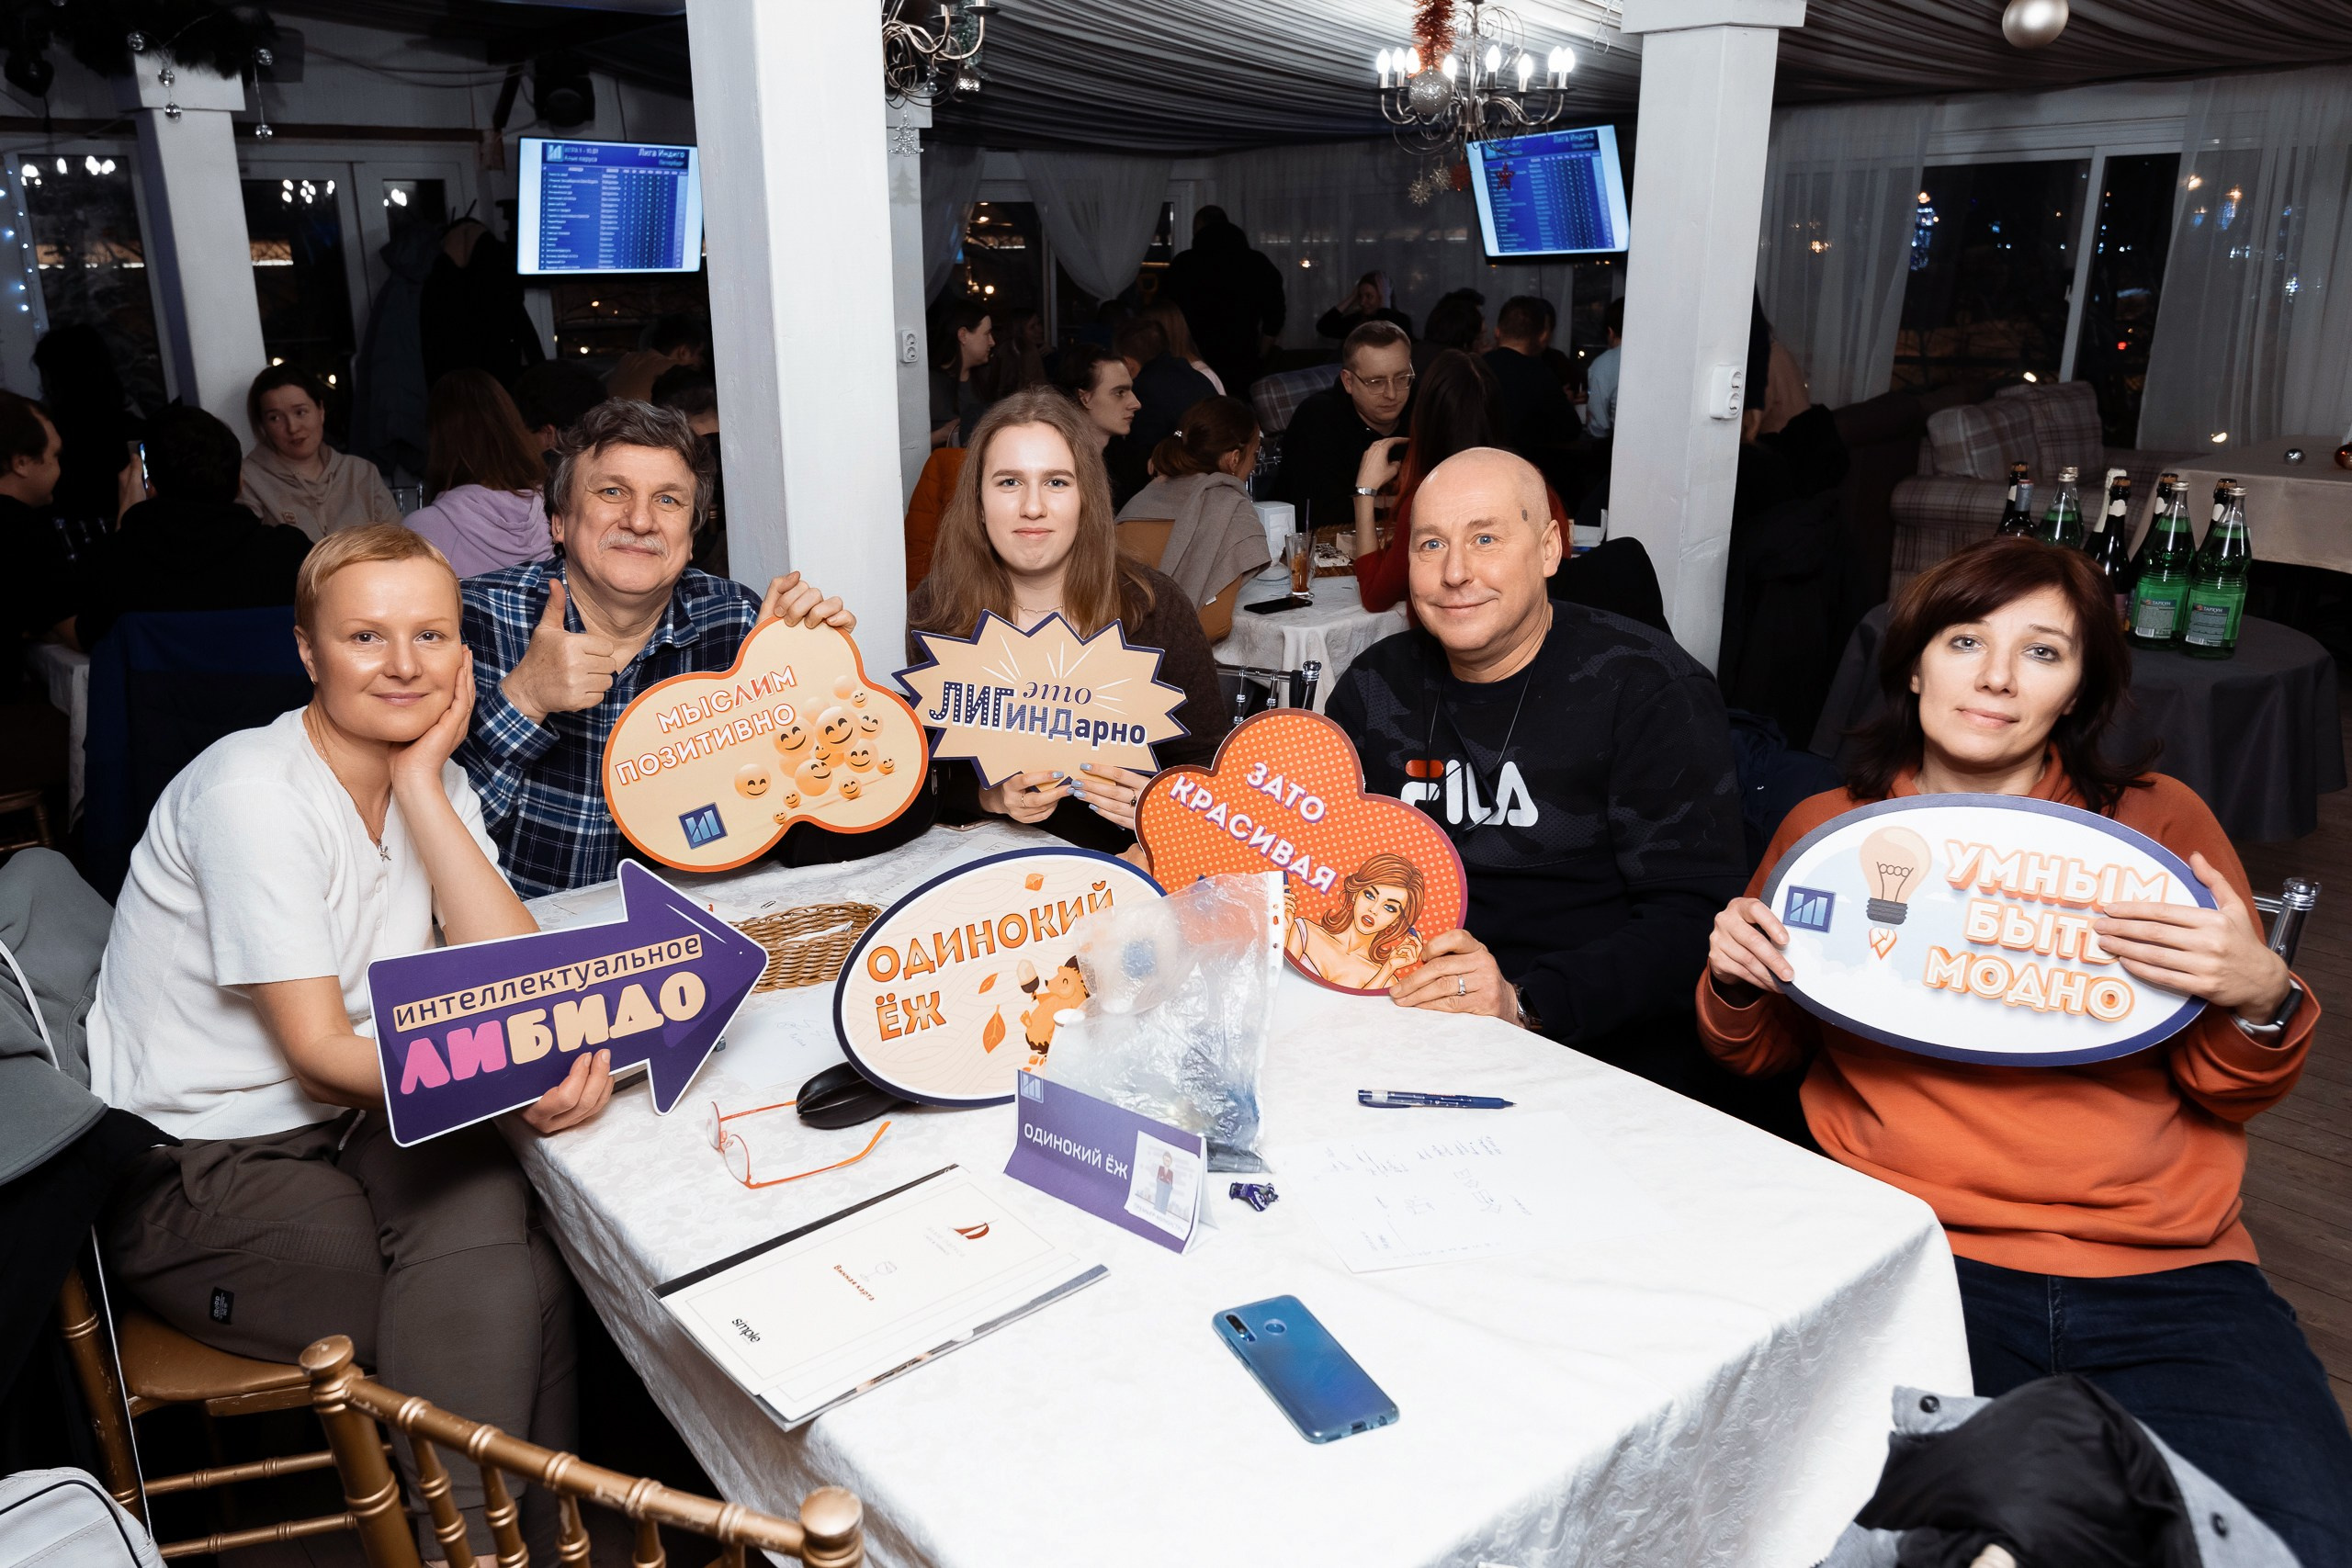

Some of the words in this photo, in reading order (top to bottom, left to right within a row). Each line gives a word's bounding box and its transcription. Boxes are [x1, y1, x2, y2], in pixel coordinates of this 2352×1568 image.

[638, 147, 658, 158] Лига
[658, 149, 685, 159] Индиго
[656, 665, 797, 734] МЫСЛИМ
[1023, 681, 1092, 705] это
[615, 703, 796, 786] ПОЗИТИВНО
[1246, 761, 1326, 824] ЗАТО
[1401, 759, 1539, 827] FILA
[1170, 774, 1339, 896] КРАСИВАЯ
[1944, 840, 2169, 912] УМНЫМ
[867, 880, 1114, 982] ОДИНОКИЙ
[396, 936, 701, 1027] интеллектуальное
[1923, 945, 2135, 1022] МОДНО
[401, 971, 706, 1095] ЛИБИДО
[876, 993, 946, 1042] ЁЖ
[1023, 1122, 1102, 1168] ОДИНОКИЙ
[1105, 1150, 1128, 1179] ЁЖ
[731, 1318, 761, 1343] simple
